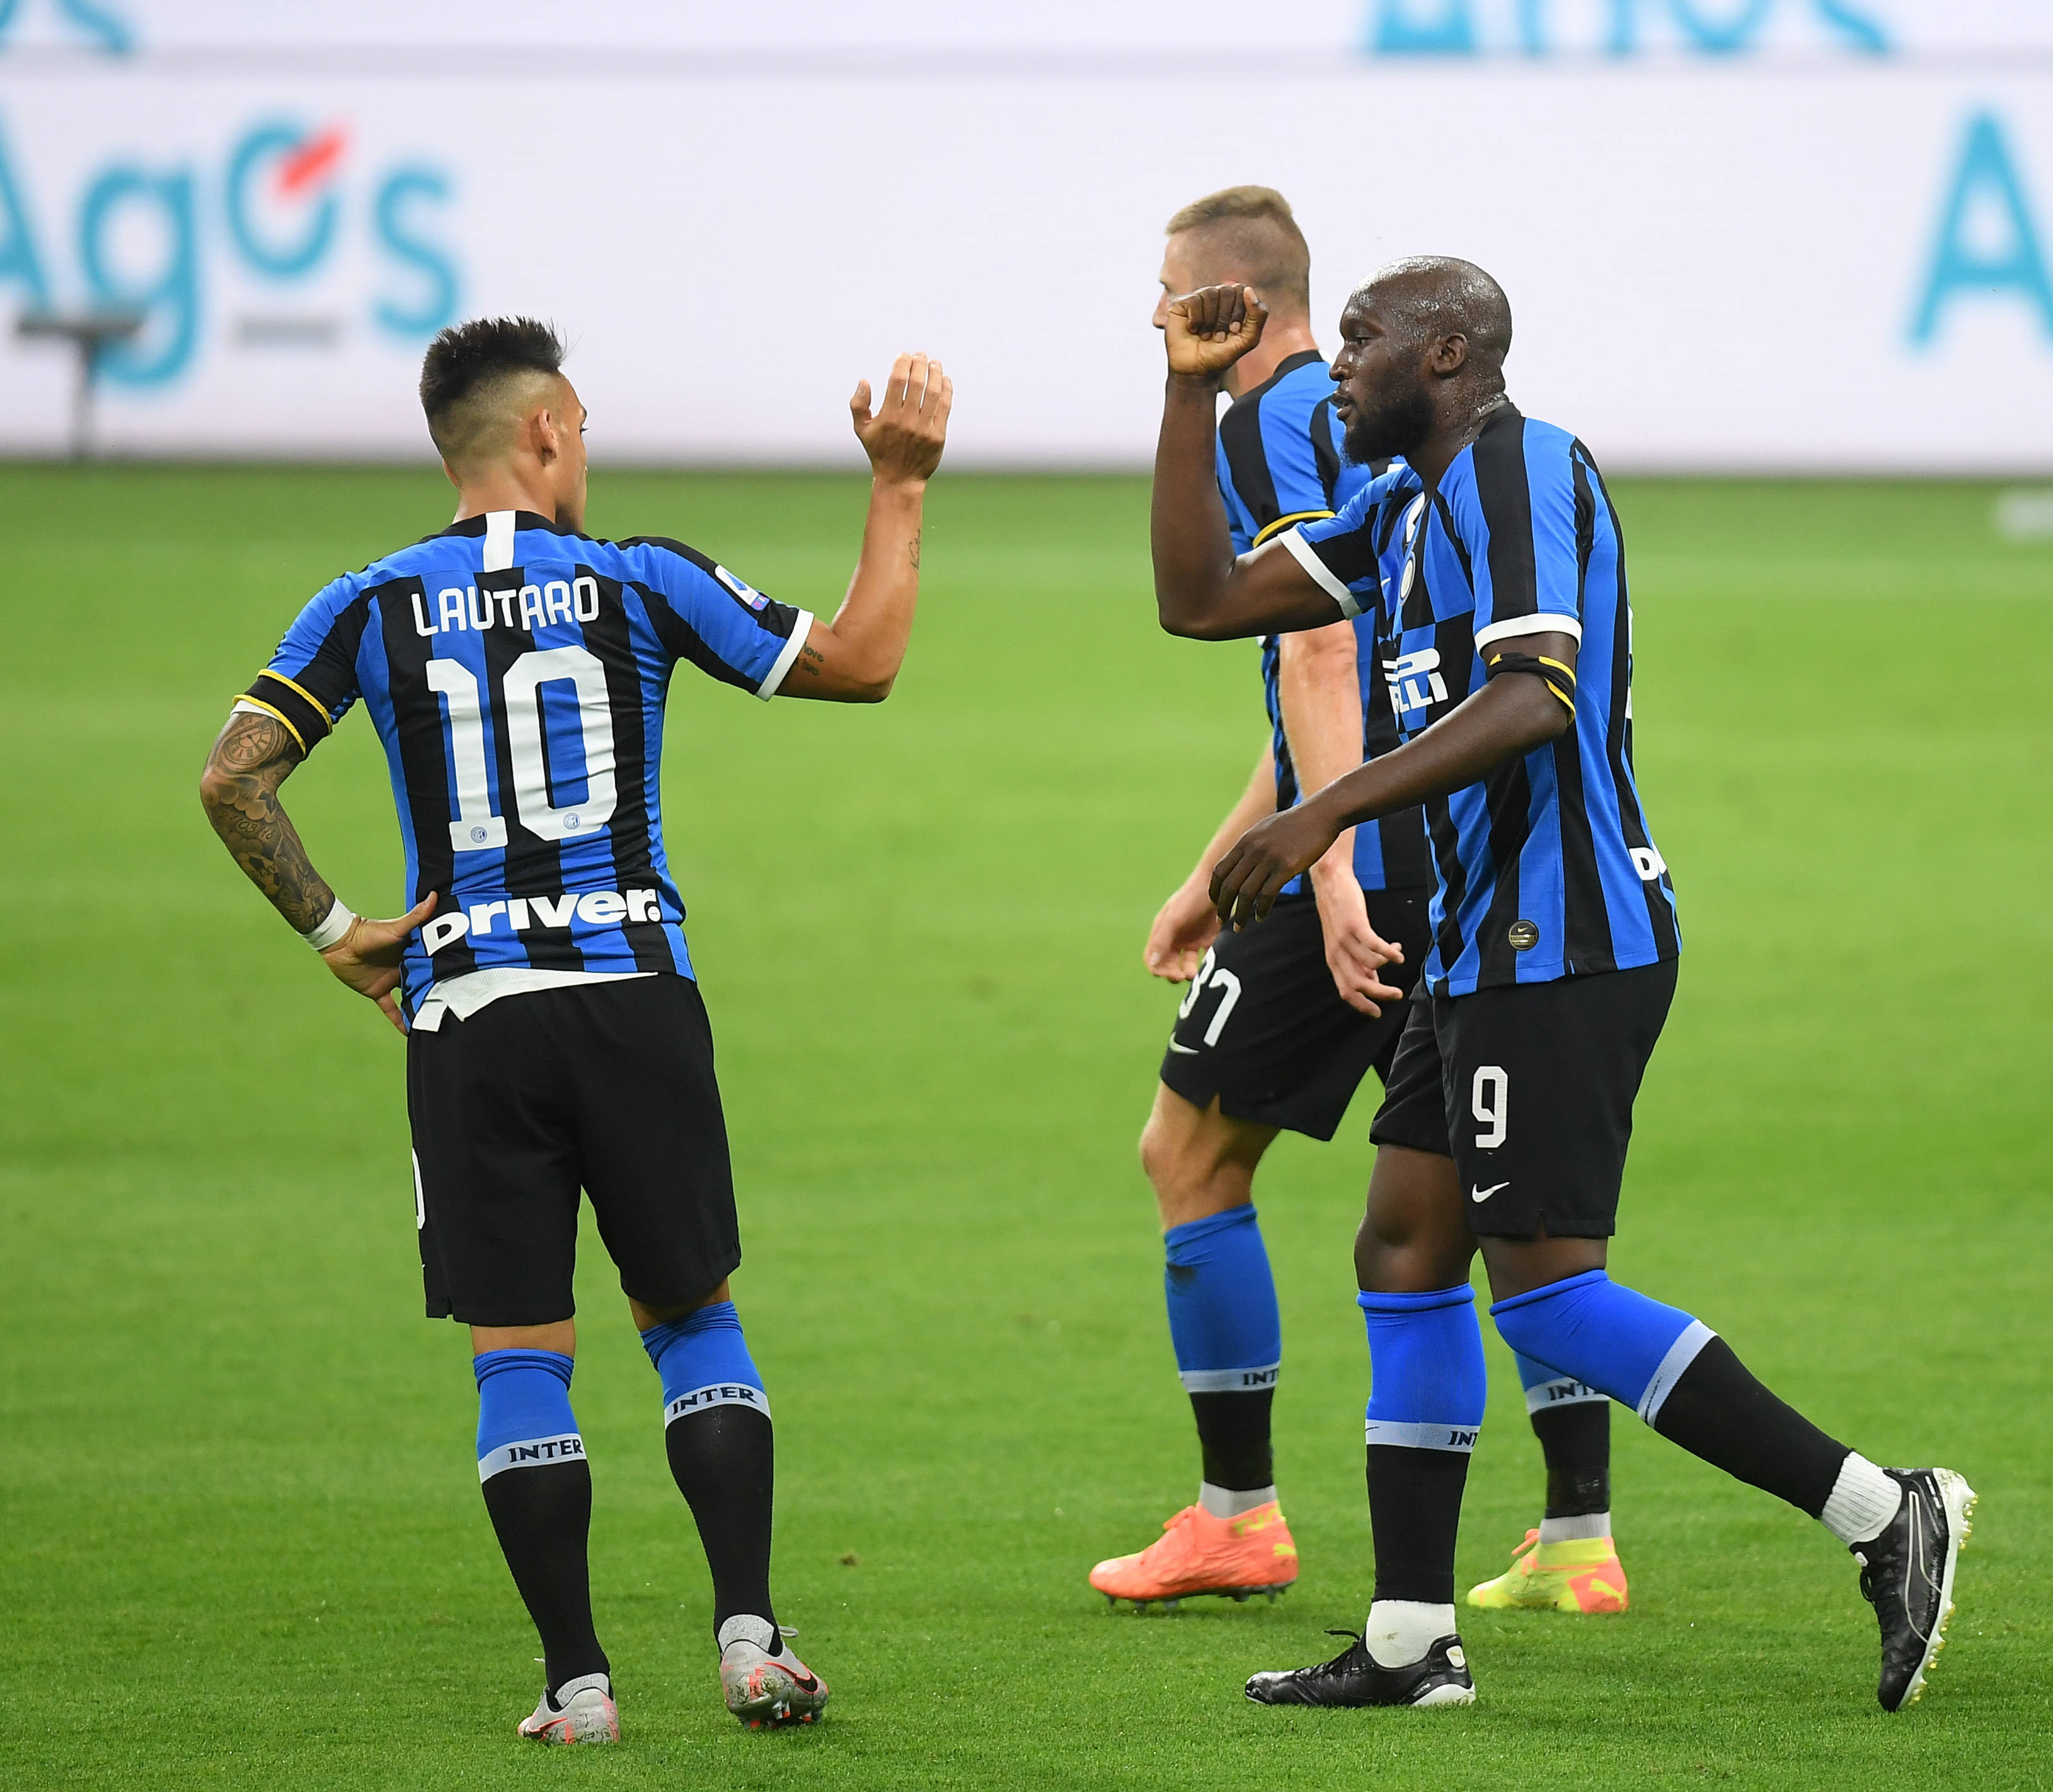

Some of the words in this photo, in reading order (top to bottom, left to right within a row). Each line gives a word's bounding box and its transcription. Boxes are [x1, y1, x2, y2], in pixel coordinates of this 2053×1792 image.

[411, 576, 599, 637] LAUTARO
[425, 645, 618, 852] 10
[1472, 1066, 1508, 1148] 9
[673, 1386, 757, 1415] INTER
[508, 1439, 584, 1462] INTER
